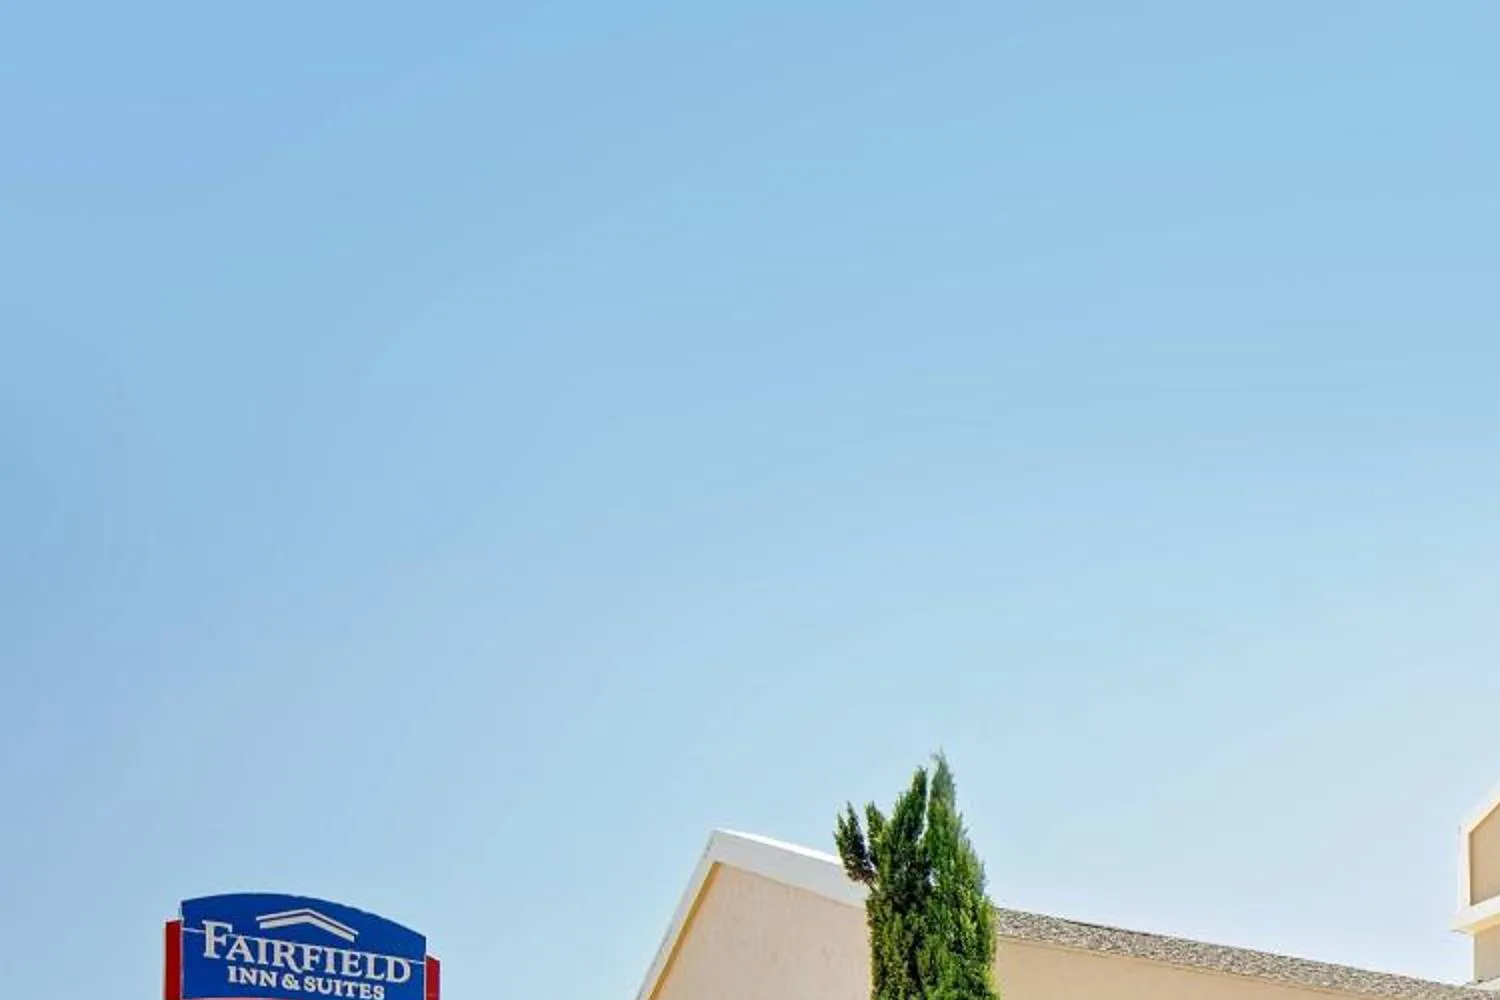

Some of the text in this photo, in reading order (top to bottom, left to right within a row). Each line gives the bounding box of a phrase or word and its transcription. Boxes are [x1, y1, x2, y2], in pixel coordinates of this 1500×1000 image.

[201, 920, 412, 983] FAIRFIELD
[227, 965, 386, 1000] INN & SUITES
